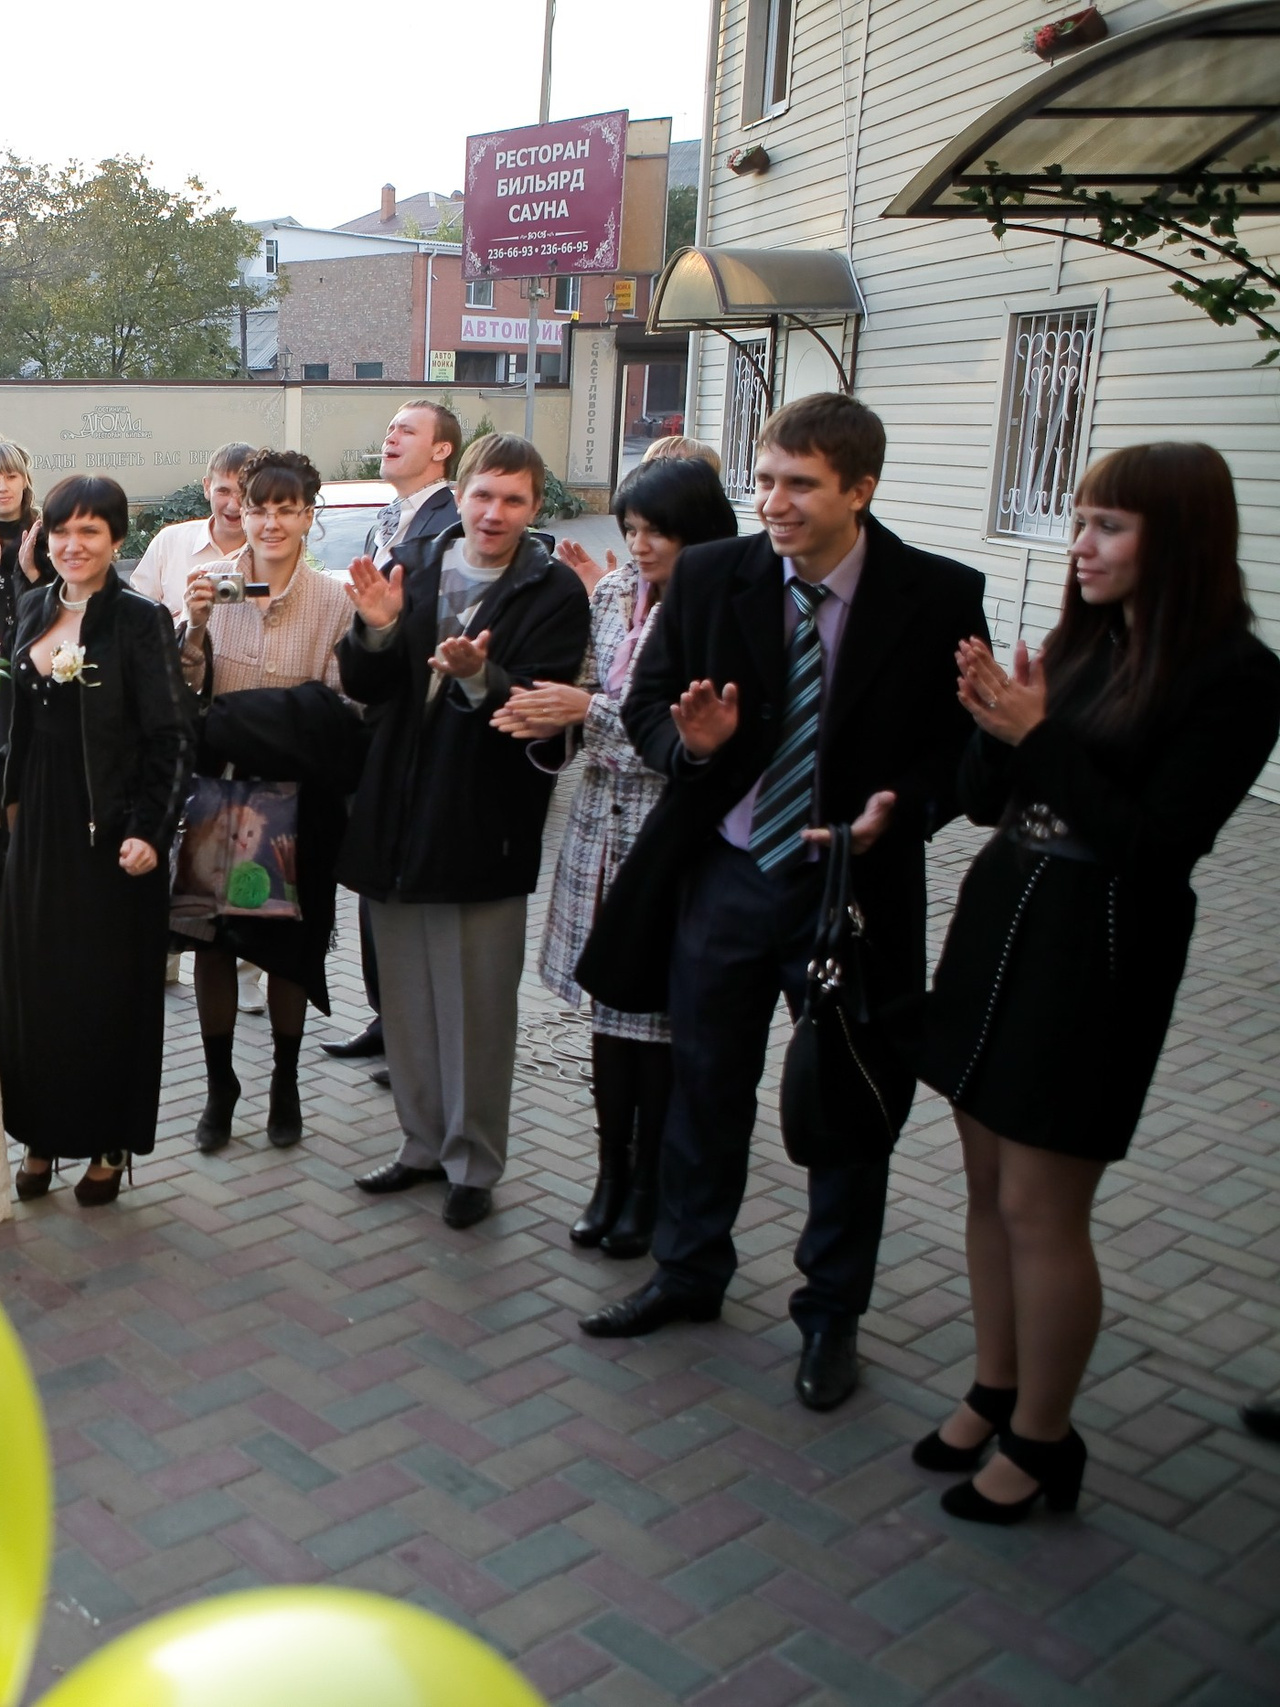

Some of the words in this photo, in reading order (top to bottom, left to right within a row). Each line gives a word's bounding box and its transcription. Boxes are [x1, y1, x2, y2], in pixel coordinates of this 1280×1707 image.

[495, 138, 590, 170] РЕСТОРАН
[497, 168, 585, 197] БИЛЬЯРД
[508, 199, 569, 223] САУНА
[487, 245, 534, 260] 236-66-93
[540, 241, 589, 256] 236-66-95
[462, 319, 564, 341] АВТОМЙК
[434, 352, 452, 360] АВТО
[586, 341, 600, 435] СЧАСТЛИВОГО
[33, 453, 76, 471] РАДЫ
[87, 451, 146, 469] ВИДЕТЬ
[154, 451, 181, 466] ВАС
[584, 439, 595, 473] ПУТИ
